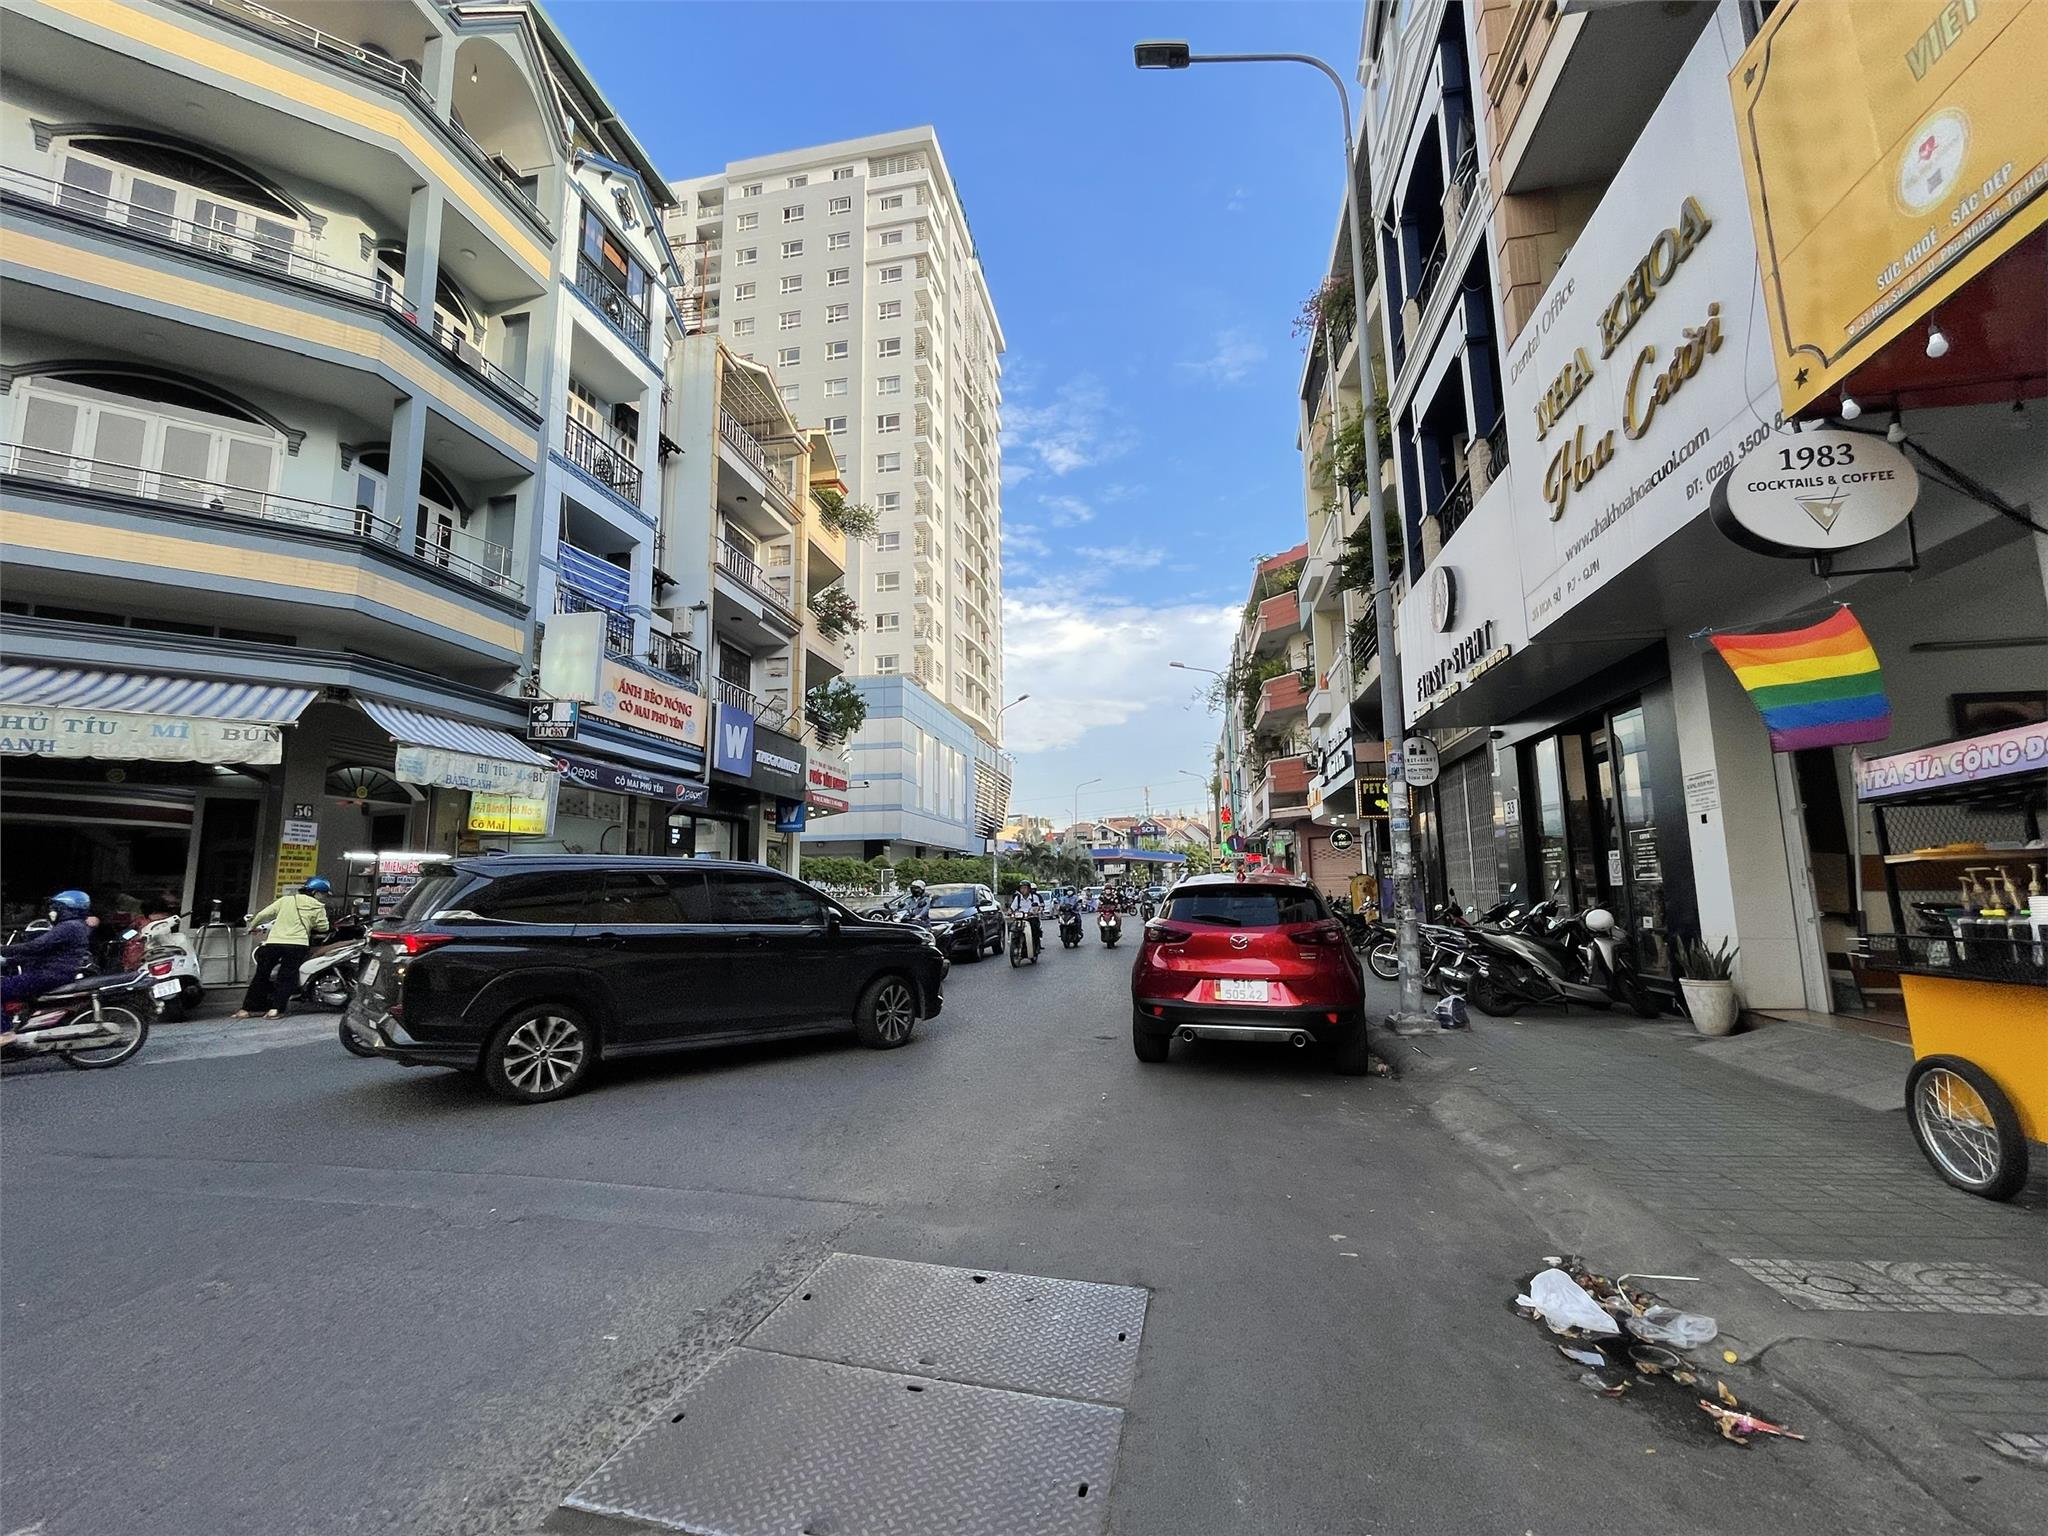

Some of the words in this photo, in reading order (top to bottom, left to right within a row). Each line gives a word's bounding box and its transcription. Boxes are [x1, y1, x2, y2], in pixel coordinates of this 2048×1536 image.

[1510, 328, 1541, 385] Dental
[1542, 277, 1576, 334] Office
[1533, 347, 1595, 442] NHA
[1596, 195, 1713, 360] KHOA
[1705, 451, 1735, 486] (028)
[1737, 422, 1770, 460] 3500
[1779, 443, 1855, 471] 1983
[1543, 424, 1615, 522] Hoa
[1747, 476, 1824, 493] COCKTAILS
[1828, 474, 1838, 485] &
[1841, 470, 1896, 484] COFFEE
[1565, 426, 1710, 562] www.nhakhoahoacuoi.com
[619, 700, 633, 713] CÔ
[634, 705, 650, 720] MAI
[651, 708, 668, 725] PHÚ
[668, 716, 684, 730] YÊN
[664, 697, 692, 718] NÓNG
[62, 716, 117, 735] TÍU
[151, 723, 190, 739] MÌ
[221, 726, 280, 743] BÚN
[534, 725, 570, 737] LUCKY
[725, 723, 749, 760] W
[1865, 761, 1900, 791] TRÀ
[1904, 754, 1945, 785] SỮA
[1950, 743, 2020, 779] CỘNG
[614, 775, 626, 786] CÔ
[626, 779, 639, 789] MAI
[640, 781, 652, 791] PHÚ
[653, 783, 664, 793] YÊN
[1363, 782, 1381, 795] PET
[295, 805, 313, 818] 56
